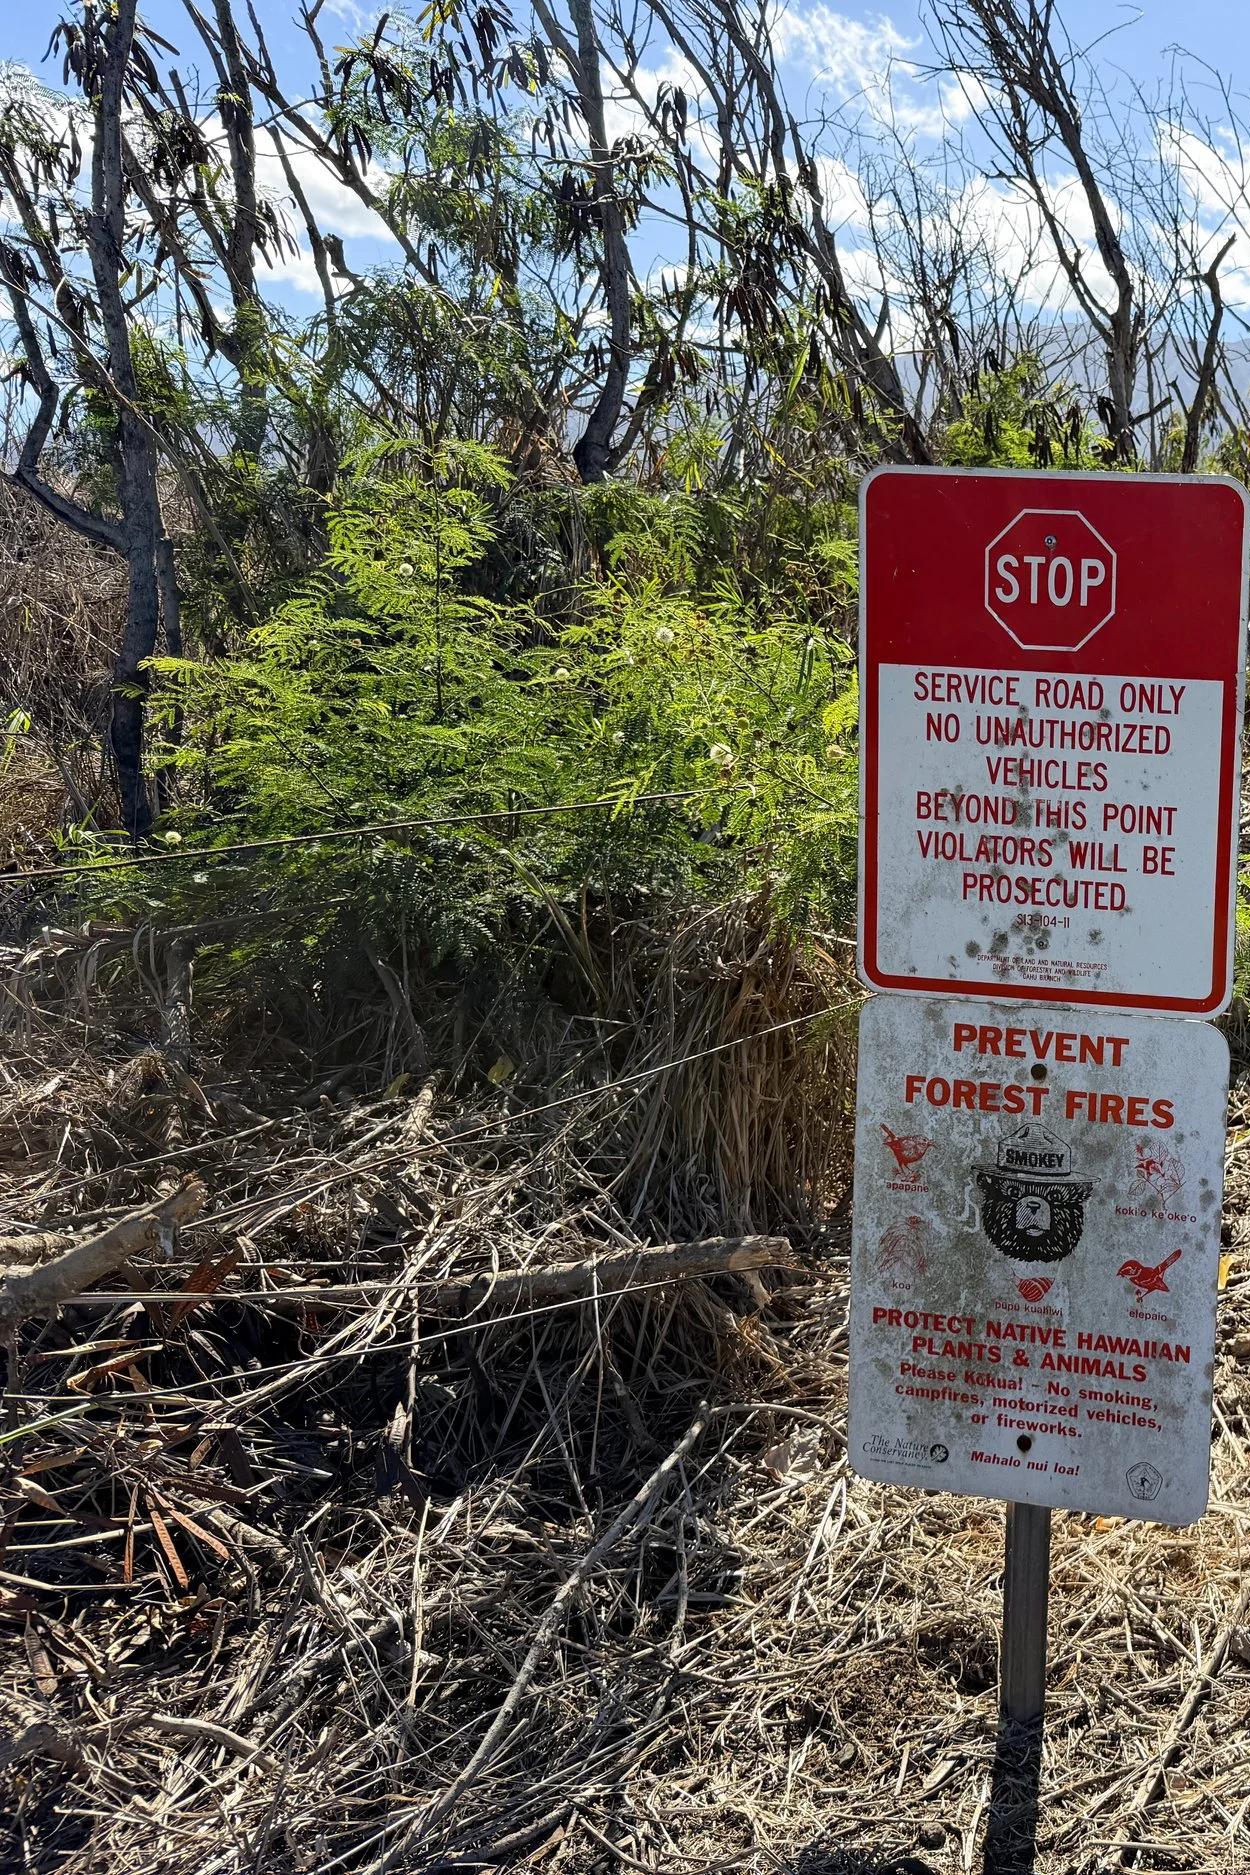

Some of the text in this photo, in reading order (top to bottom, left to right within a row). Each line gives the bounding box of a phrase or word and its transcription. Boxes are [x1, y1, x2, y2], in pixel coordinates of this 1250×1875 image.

[995, 554, 1106, 607] STOP
[914, 672, 1186, 715] SERVICE ROAD ONLY
[926, 712, 1172, 755] NO UNAUTHORIZED
[986, 756, 1108, 792] VEHICLES
[916, 791, 1178, 836] BEYOND THIS POINT
[917, 830, 1176, 876] VIOLATORS WILL BE
[962, 872, 1126, 912] PROSECUTED
[1050, 960, 1074, 968] NATURAL
[1076, 962, 1108, 970] RESOURCES
[953, 1022, 1130, 1067] PREVENT
[905, 1074, 1176, 1130] FOREST FIRES
[1005, 1148, 1066, 1168] SMOKEY
[892, 1280, 911, 1290] koa
[872, 1306, 1191, 1364] PROTECT NATIVE HAWAIIAN
[911, 1335, 1148, 1382] PLANTS & ANIMALS
[895, 1382, 1162, 1432] campfires, motorized vehicles,
[900, 1362, 956, 1382] Please
[1048, 1382, 1070, 1397] No
[1078, 1388, 1158, 1412] smoking,
[871, 1434, 929, 1452] The Nature
[970, 1413, 1082, 1438] or fireworks.
[970, 1450, 1080, 1476] Mahalo nui loa!
